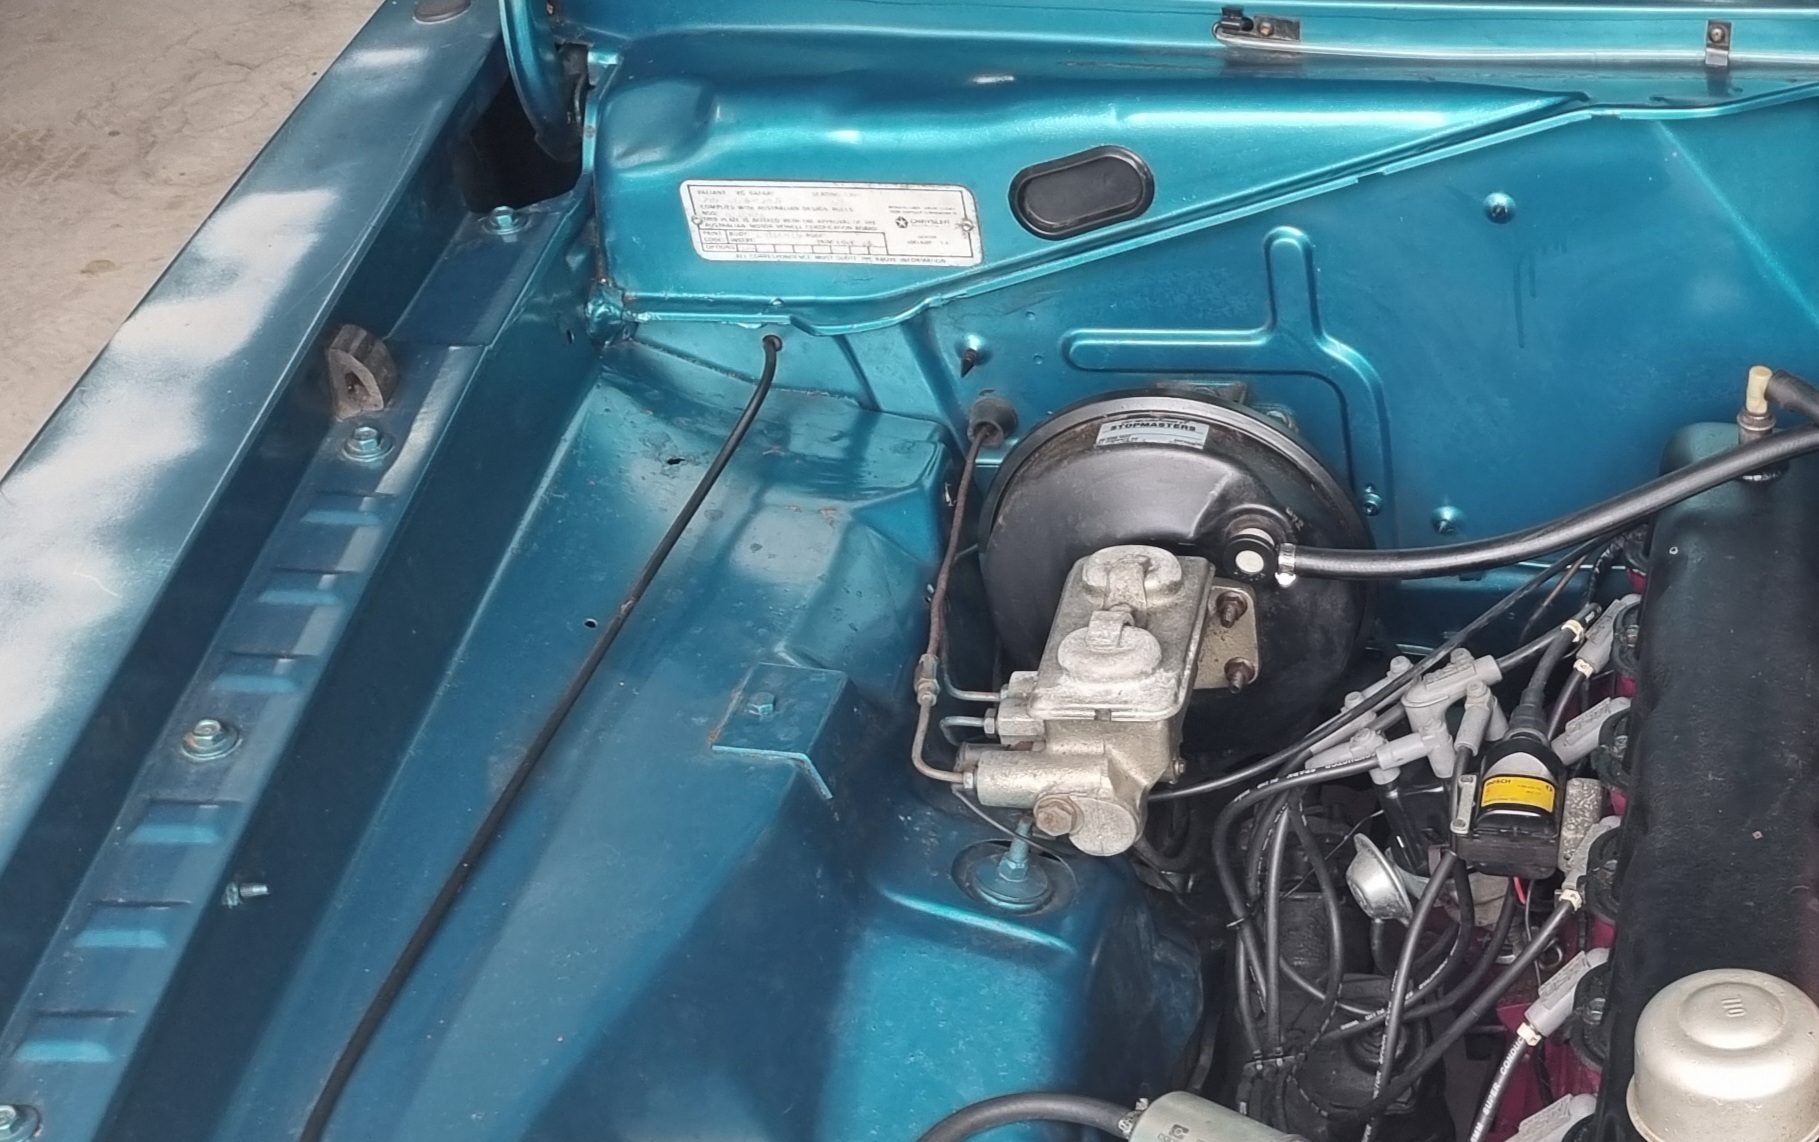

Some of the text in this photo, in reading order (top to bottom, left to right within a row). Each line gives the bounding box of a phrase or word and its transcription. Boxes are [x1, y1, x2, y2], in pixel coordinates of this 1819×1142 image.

[1110, 422, 1197, 431] STOPMASTERS
[1482, 1081, 1501, 1116] SUPER
[1499, 1035, 1525, 1076] CONDUC
